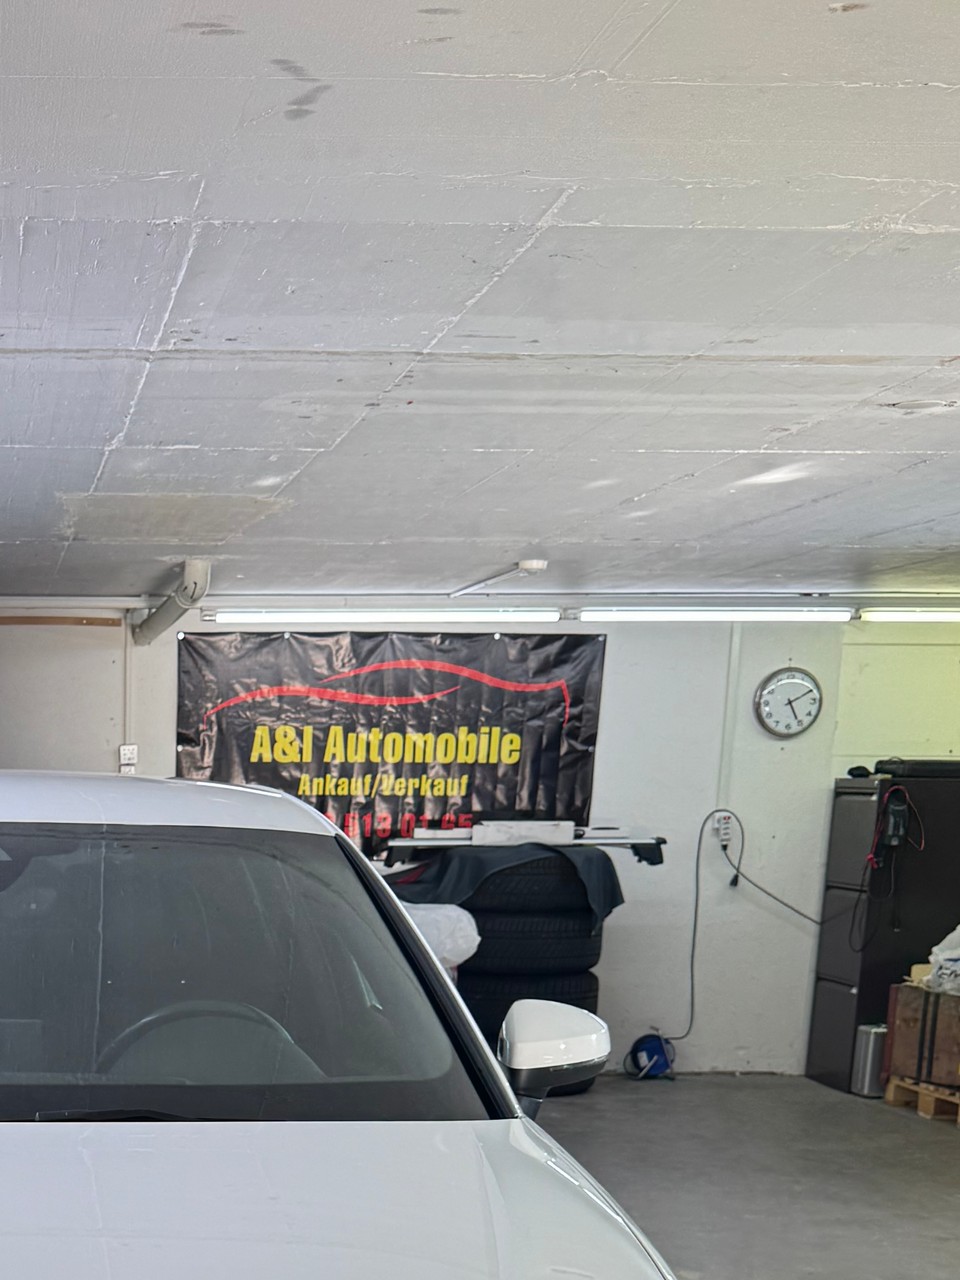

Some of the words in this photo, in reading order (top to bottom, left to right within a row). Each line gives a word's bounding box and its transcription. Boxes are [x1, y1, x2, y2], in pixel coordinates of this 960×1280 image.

[250, 725, 313, 763] A&I
[323, 725, 522, 765] Automobile
[297, 773, 470, 799] Ankauf/Verkauf
[344, 812, 393, 838] 513
